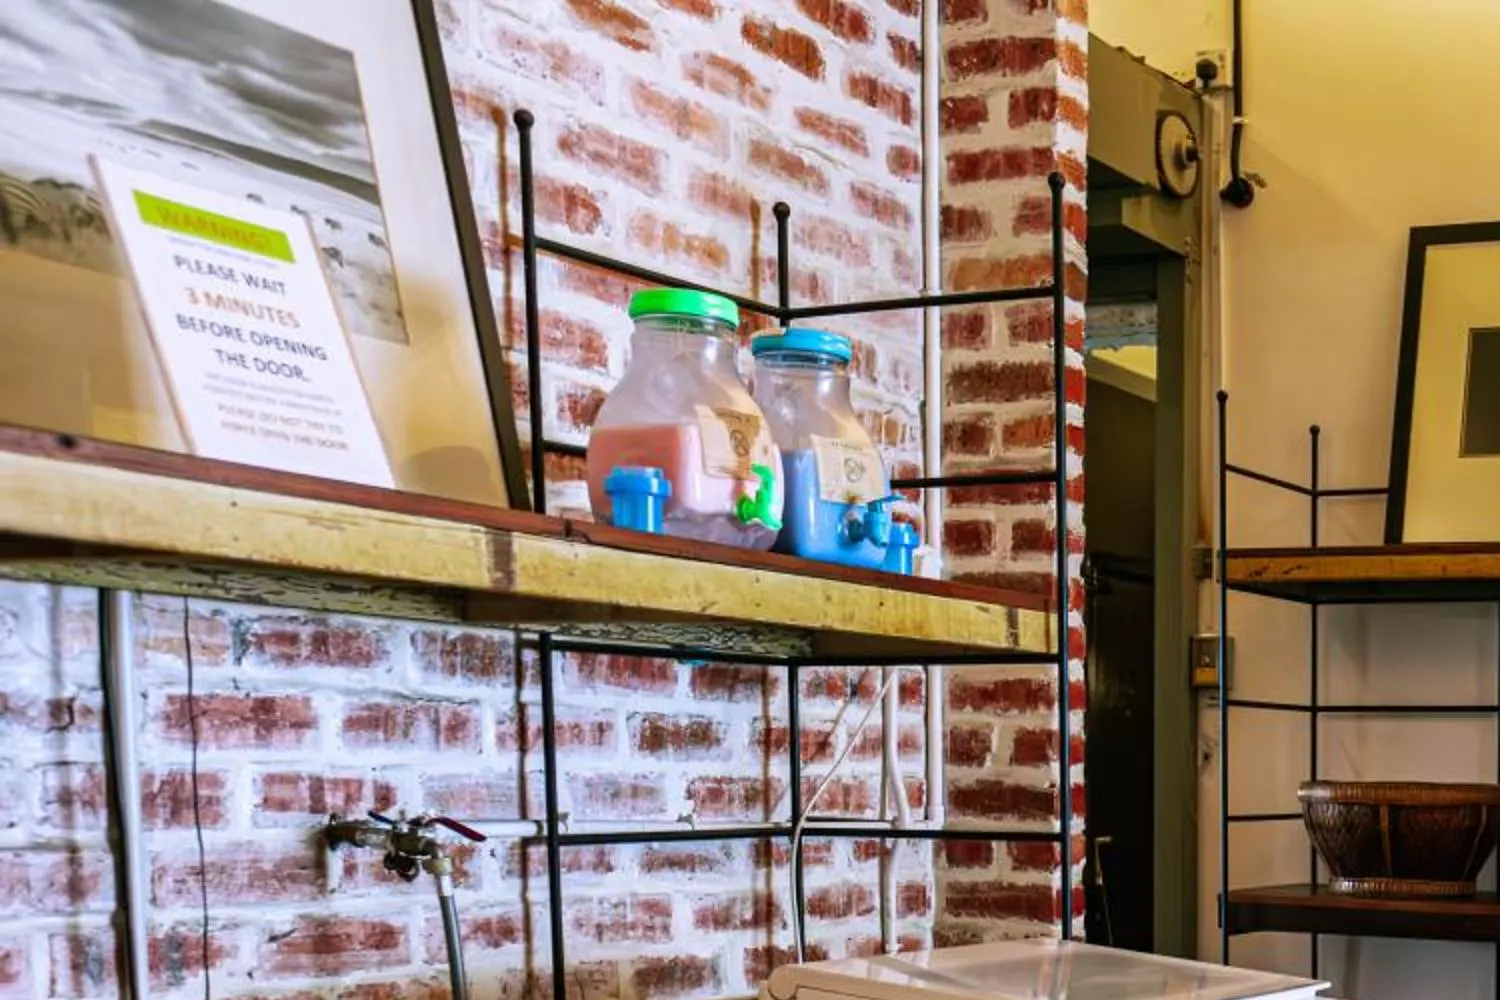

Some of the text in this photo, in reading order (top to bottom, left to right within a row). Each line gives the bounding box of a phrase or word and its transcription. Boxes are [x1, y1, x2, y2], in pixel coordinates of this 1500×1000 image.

[173, 254, 286, 295] PLEASE WAIT
[184, 286, 301, 328] 3 MINUTES
[175, 313, 329, 361] BEFORE OPENING
[213, 348, 250, 370] THE
